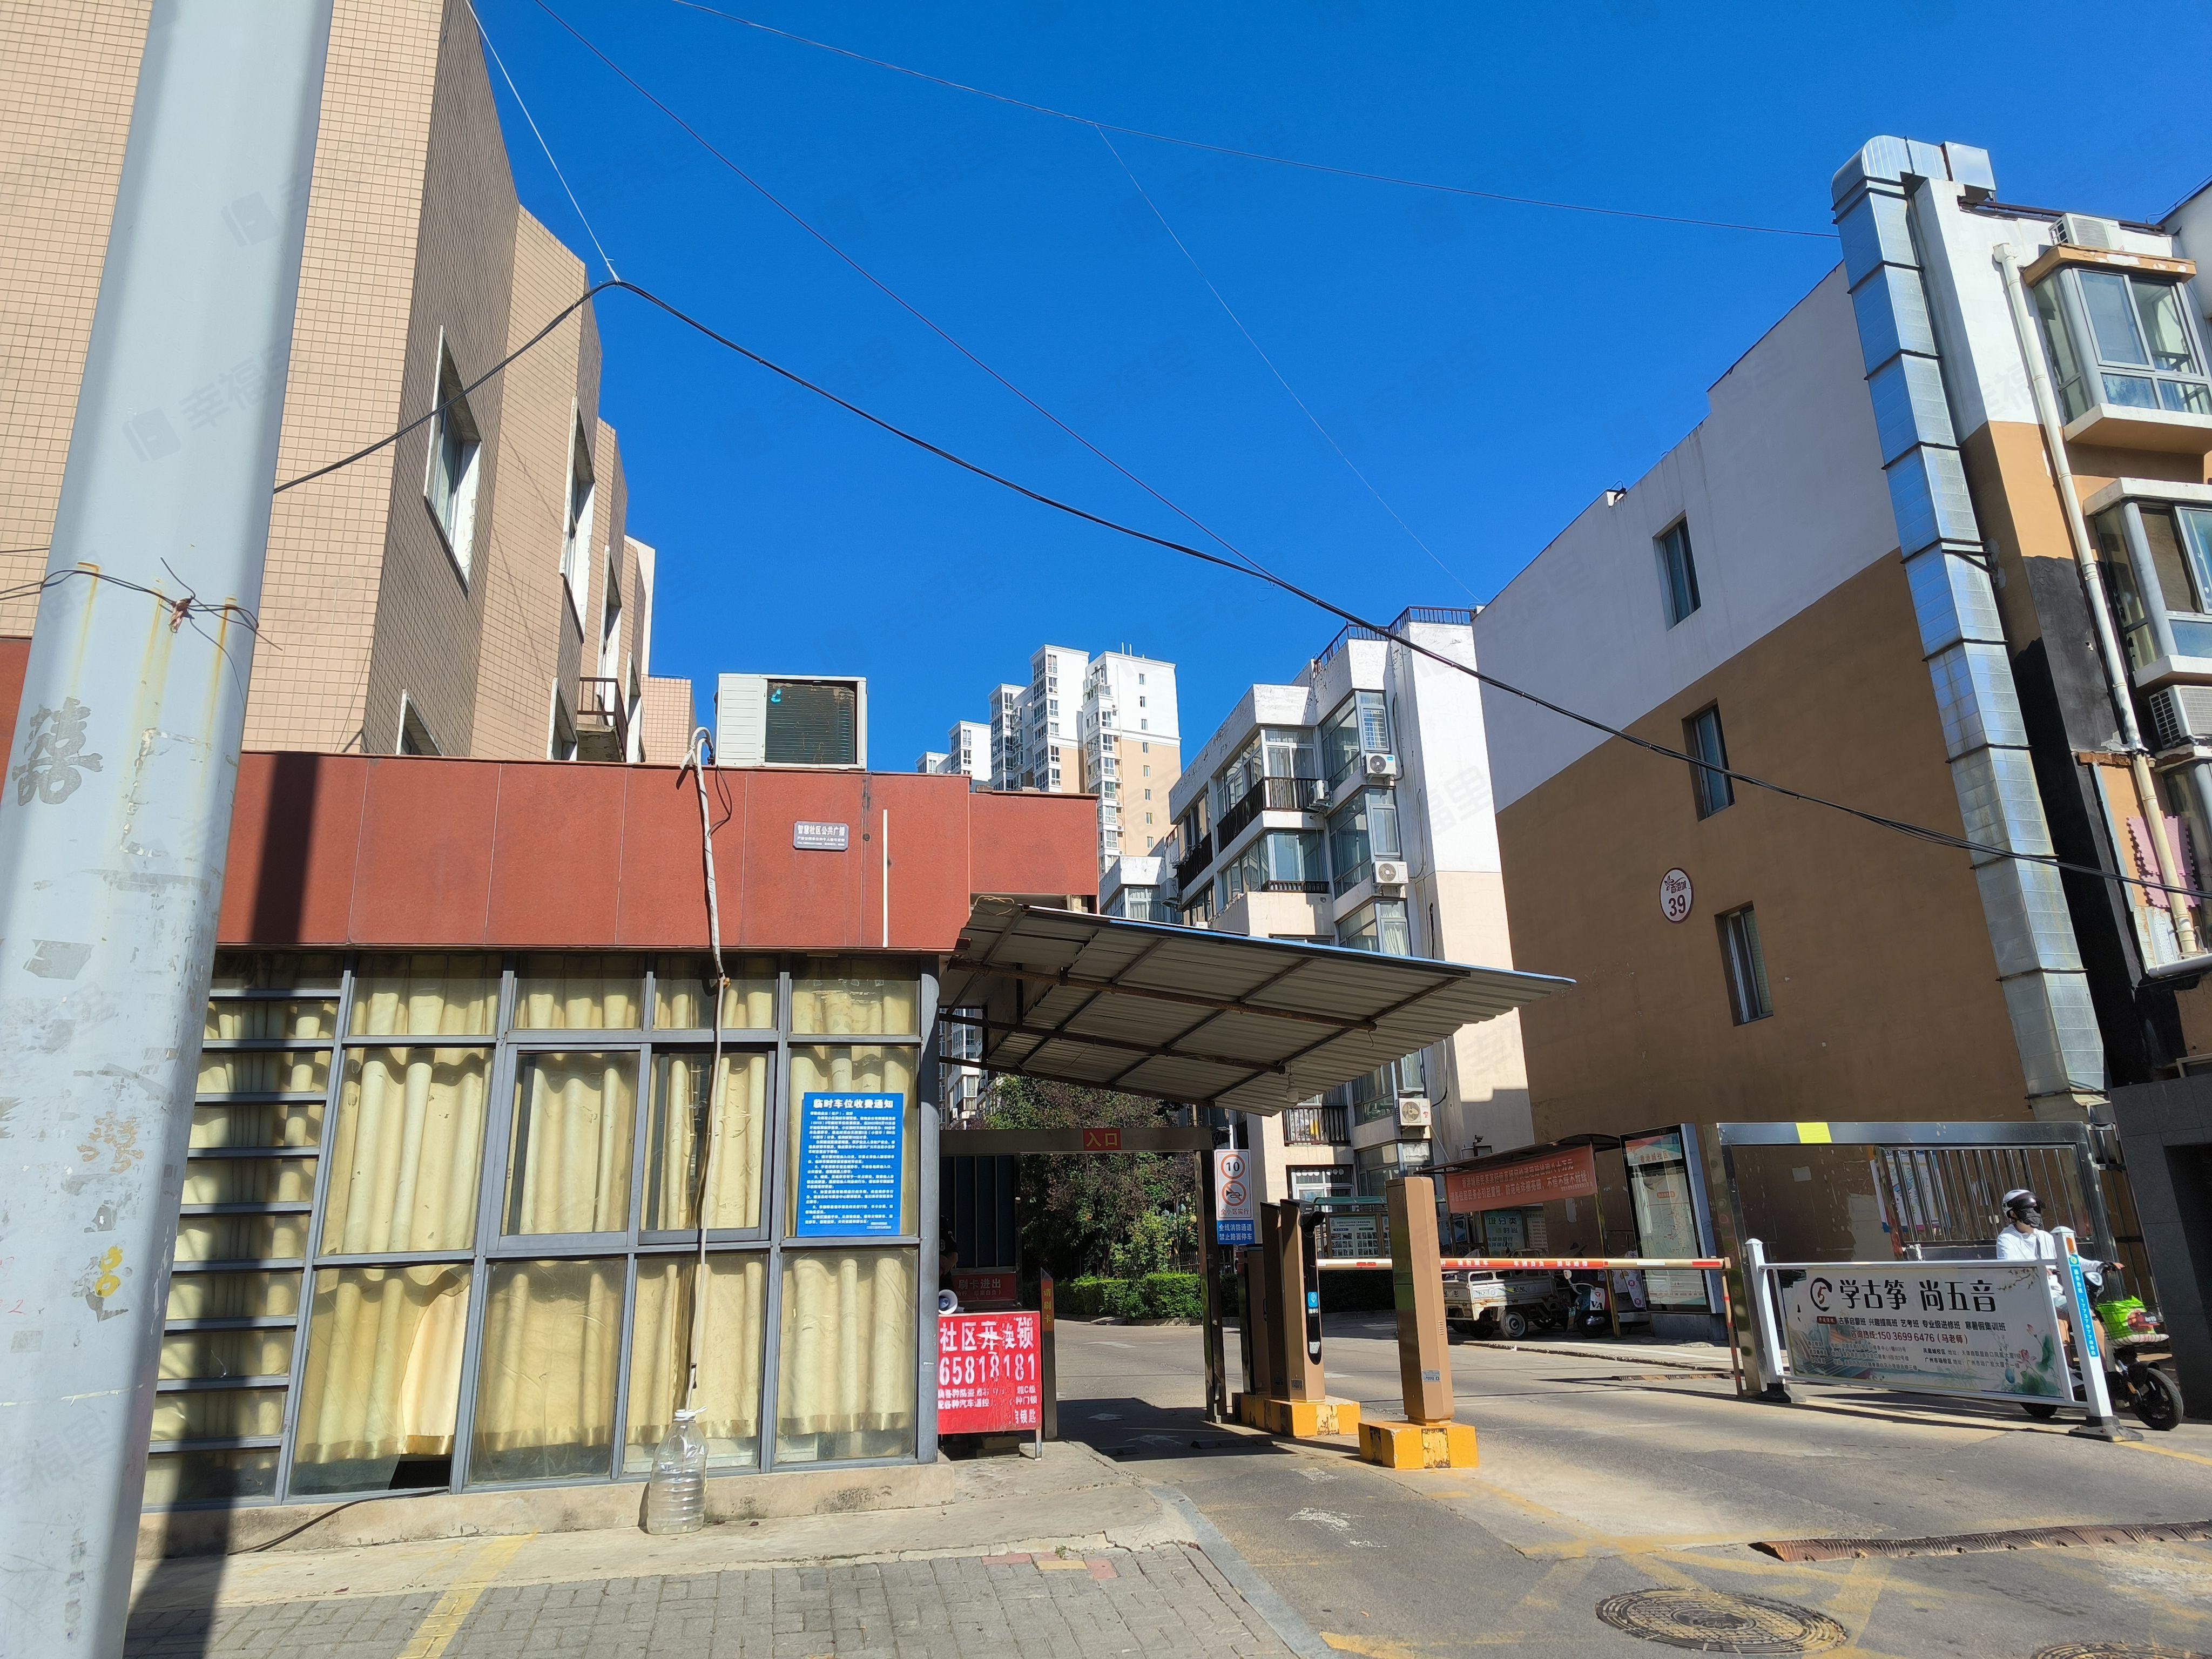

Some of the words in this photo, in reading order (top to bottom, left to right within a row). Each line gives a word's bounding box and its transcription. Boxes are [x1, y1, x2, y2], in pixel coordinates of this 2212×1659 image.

[1668, 894, 1686, 916] 39
[813, 1098, 893, 1109] 临时车位收费通知
[1086, 1132, 1117, 1147] 入口
[1226, 1162, 1240, 1172] 10
[1219, 1223, 1252, 1231] 全线消防通道
[1219, 1233, 1252, 1241] 禁止路面停车
[958, 1278, 1001, 1290] 刷卡进出
[1839, 1279, 1907, 1311] 学古筝
[1919, 1279, 1996, 1312] 尚五音
[1043, 1288, 1052, 1324] 请刷卡
[1900, 1319, 1919, 1328] 艺考班
[939, 1352, 1035, 1386] 65818181
